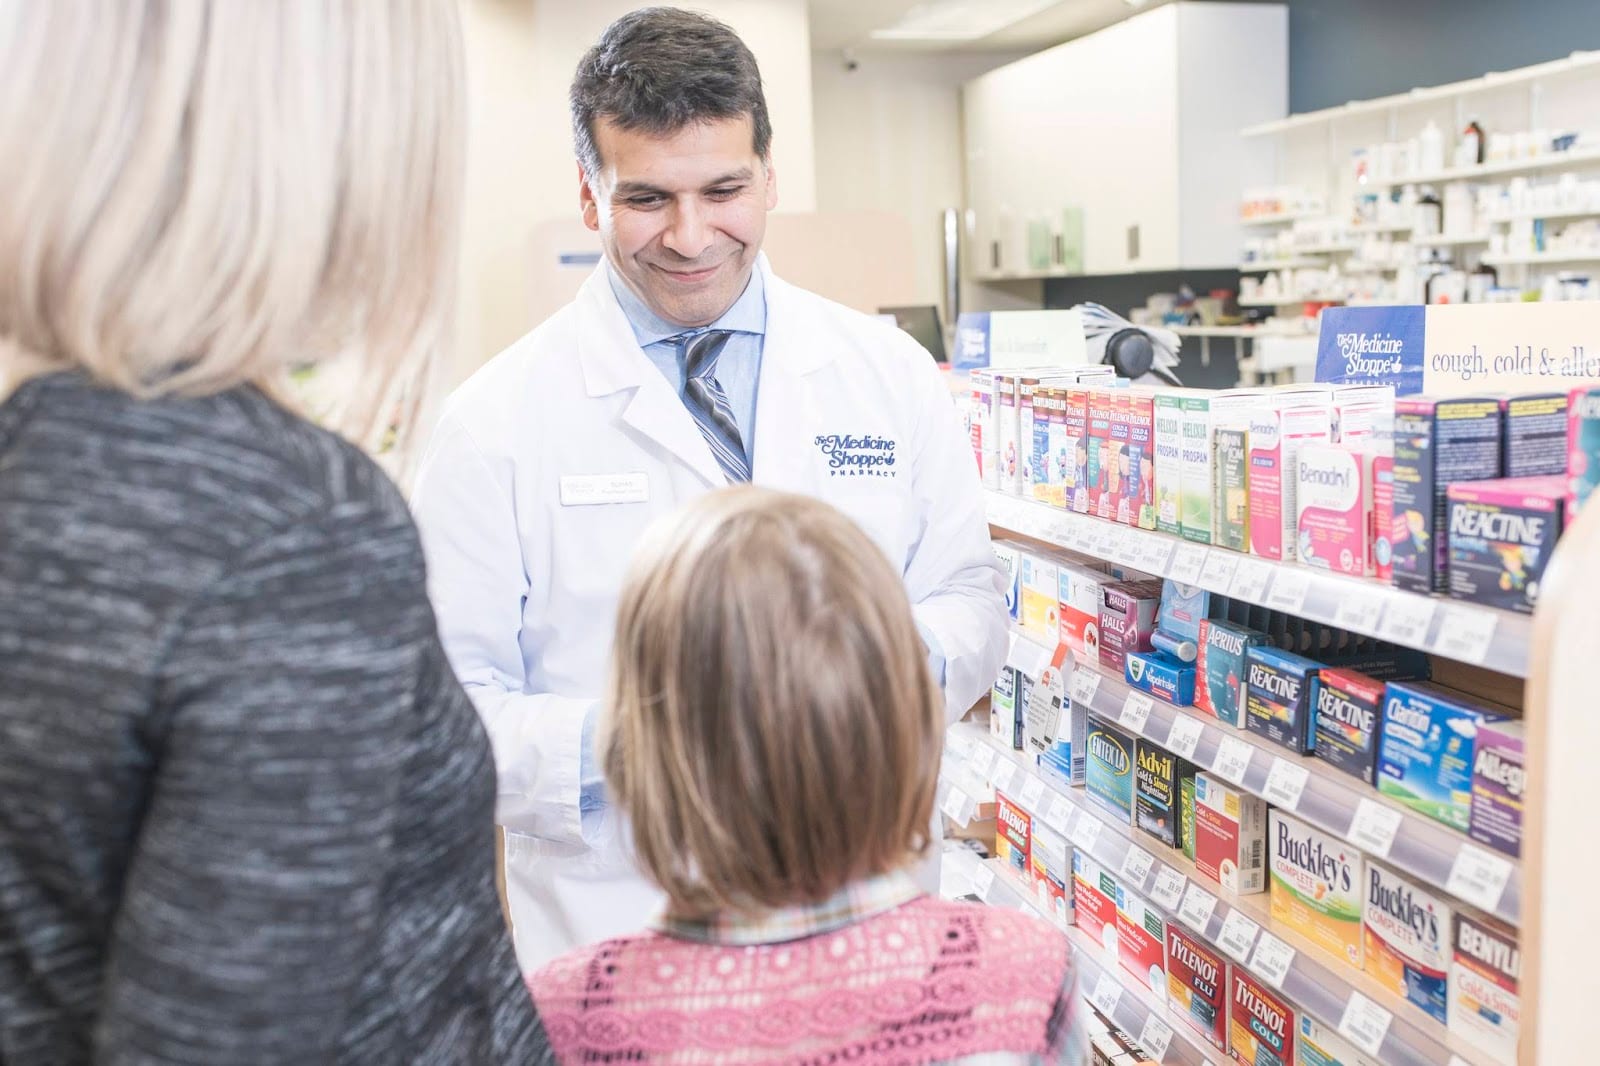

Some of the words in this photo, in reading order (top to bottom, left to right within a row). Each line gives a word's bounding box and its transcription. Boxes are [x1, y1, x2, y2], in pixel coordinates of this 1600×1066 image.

[1342, 333, 1403, 357] Medicine
[1346, 355, 1392, 376] Shoppe
[1432, 345, 1488, 381] cough,
[1494, 346, 1532, 375] cold
[1540, 347, 1556, 375] &
[1066, 405, 1085, 417] TYLENOL
[1089, 407, 1110, 420] TYLENOL
[1110, 409, 1130, 423] TYLENOL
[1129, 412, 1151, 426] TYLENOL
[1111, 430, 1128, 438] COUGH
[1112, 424, 1123, 432] COLD
[1132, 427, 1143, 435] COLD
[1182, 421, 1207, 440] HELIXIA
[822, 434, 896, 454] Medicine
[1157, 444, 1179, 459] PROSPAN
[1182, 449, 1207, 464] PROSPAN
[829, 450, 884, 468] Shoppe
[831, 469, 897, 478] PHARMACY
[1300, 462, 1351, 490] Benadryl
[1451, 504, 1545, 545] REACTINE
[1109, 594, 1127, 607] HALLS
[1101, 613, 1125, 633] HALLS
[1249, 664, 1301, 701] REACTINE
[1317, 687, 1375, 732] REACTINE
[1387, 697, 1431, 733] Claritin
[1092, 735, 1115, 766] ENTEX
[1115, 751, 1125, 770] LA
[1137, 747, 1171, 780] Advil
[1137, 767, 1148, 782] Cold
[1154, 777, 1168, 793] Sinus
[1474, 750, 1525, 795] Alleg
[1141, 781, 1168, 803] Nighttime
[998, 800, 1029, 837] TYLENOL
[1278, 820, 1351, 892] Buckley's
[1276, 860, 1313, 888] COMPLETE
[1369, 867, 1438, 943] Buckley's
[1368, 907, 1413, 945] COMPLETE
[1170, 932, 1218, 987] TYLENOL
[1459, 921, 1520, 980] BENYLI
[1194, 976, 1213, 998] FLU
[1235, 977, 1287, 1038] TYLENOL
[1491, 994, 1520, 1022] Sinu
[1252, 1020, 1281, 1048] COLD
